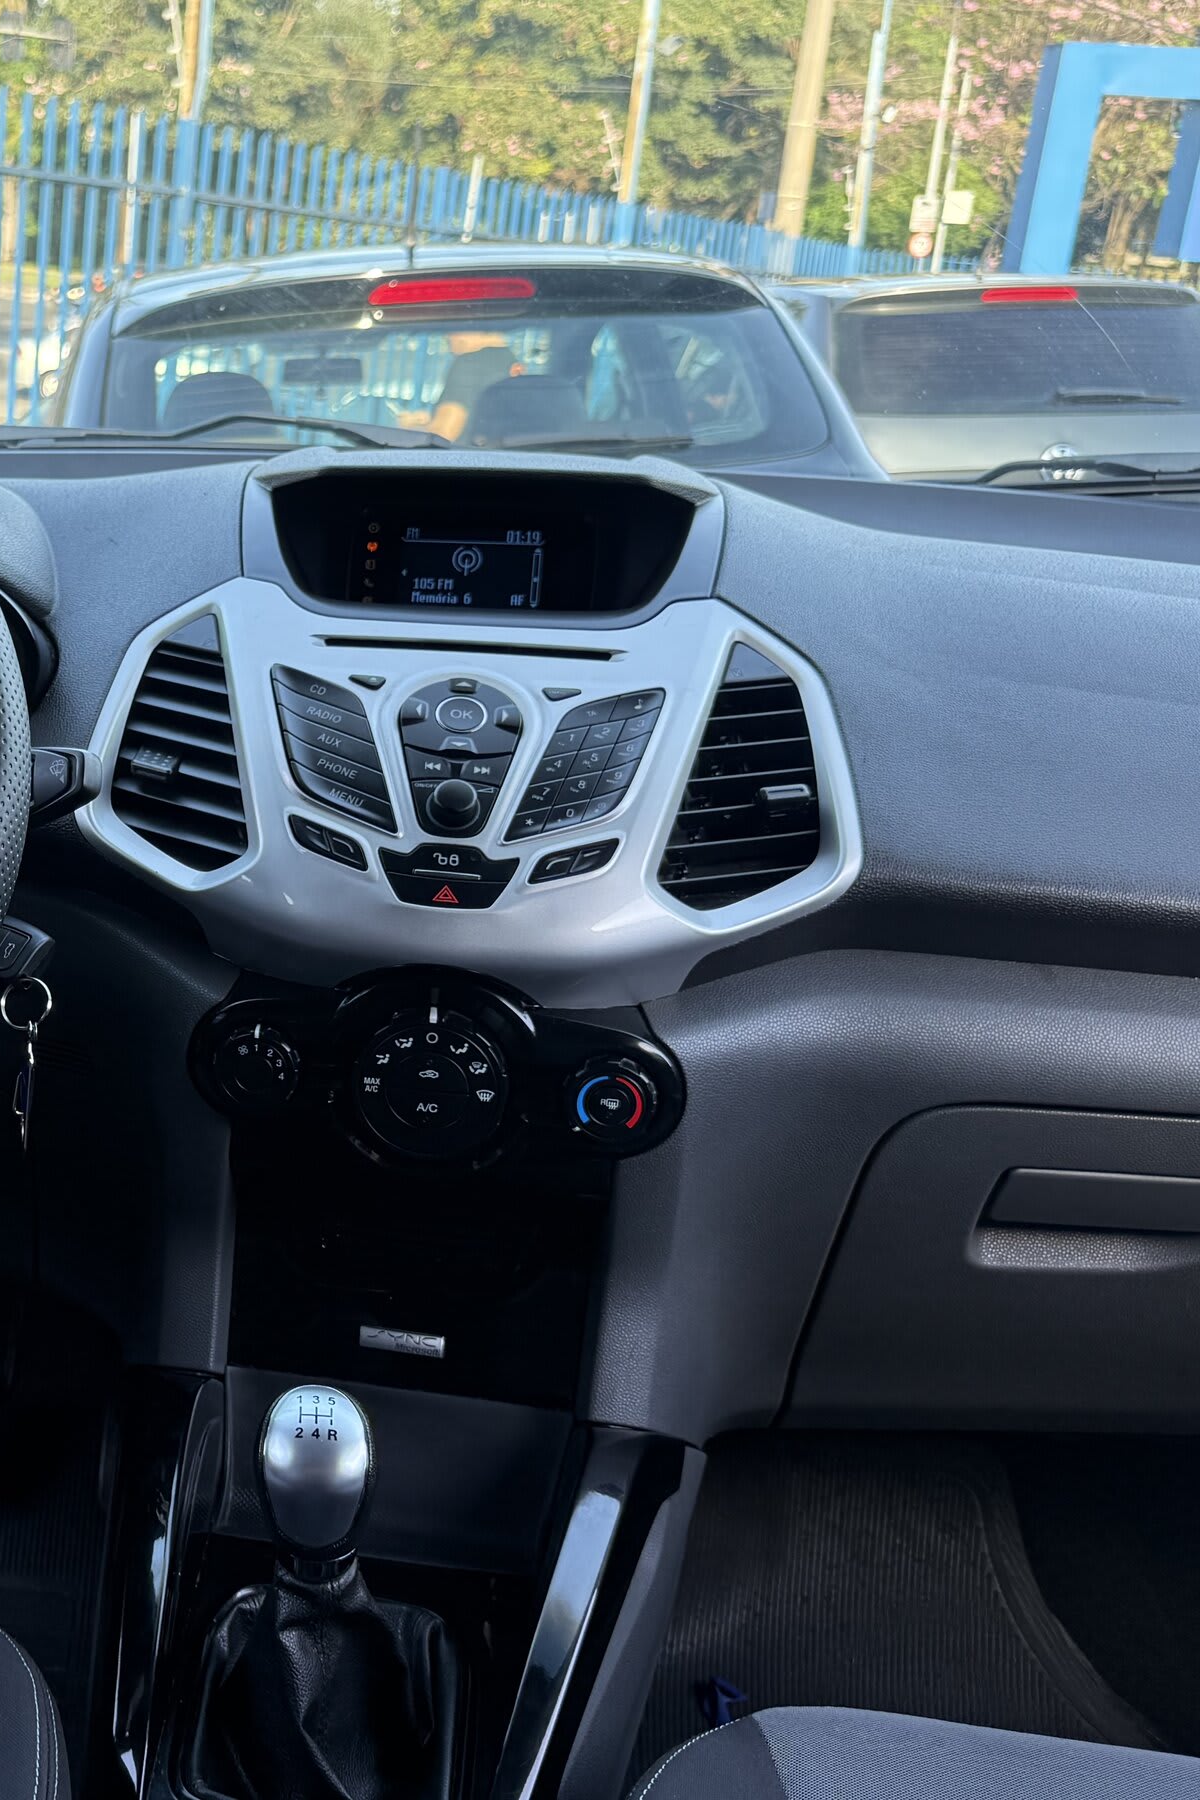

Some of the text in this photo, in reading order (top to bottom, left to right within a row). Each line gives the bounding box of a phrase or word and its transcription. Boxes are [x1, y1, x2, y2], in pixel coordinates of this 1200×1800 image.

[406, 527, 419, 539] FM
[506, 530, 541, 544] 01:19
[412, 578, 454, 590] 105 FM
[463, 592, 472, 605] 6
[510, 594, 525, 606] AF
[309, 684, 327, 696] CD
[306, 706, 342, 724] RADIO
[450, 708, 474, 720] OK
[637, 719, 645, 728] 3
[601, 727, 611, 736] 2
[317, 733, 342, 749] AUX
[569, 734, 575, 742] 1
[626, 744, 634, 753] 6
[591, 753, 599, 762] 5
[553, 759, 562, 768] 4
[317, 758, 359, 780] PHONE
[614, 771, 623, 780] 9
[577, 780, 586, 790] 8
[542, 788, 550, 796] 7
[329, 788, 364, 807] MENU
[566, 809, 574, 818] 0
[267, 1048, 274, 1057] 2
[275, 1059, 282, 1067] 3
[278, 1072, 285, 1080] 4
[363, 1077, 381, 1085] MAX
[364, 1085, 379, 1093] A/C
[416, 1102, 439, 1113] A/C
[367, 1329, 438, 1349] SYNC
[296, 1395, 336, 1406] 1 3 5
[295, 1427, 338, 1441] 2 4 R
